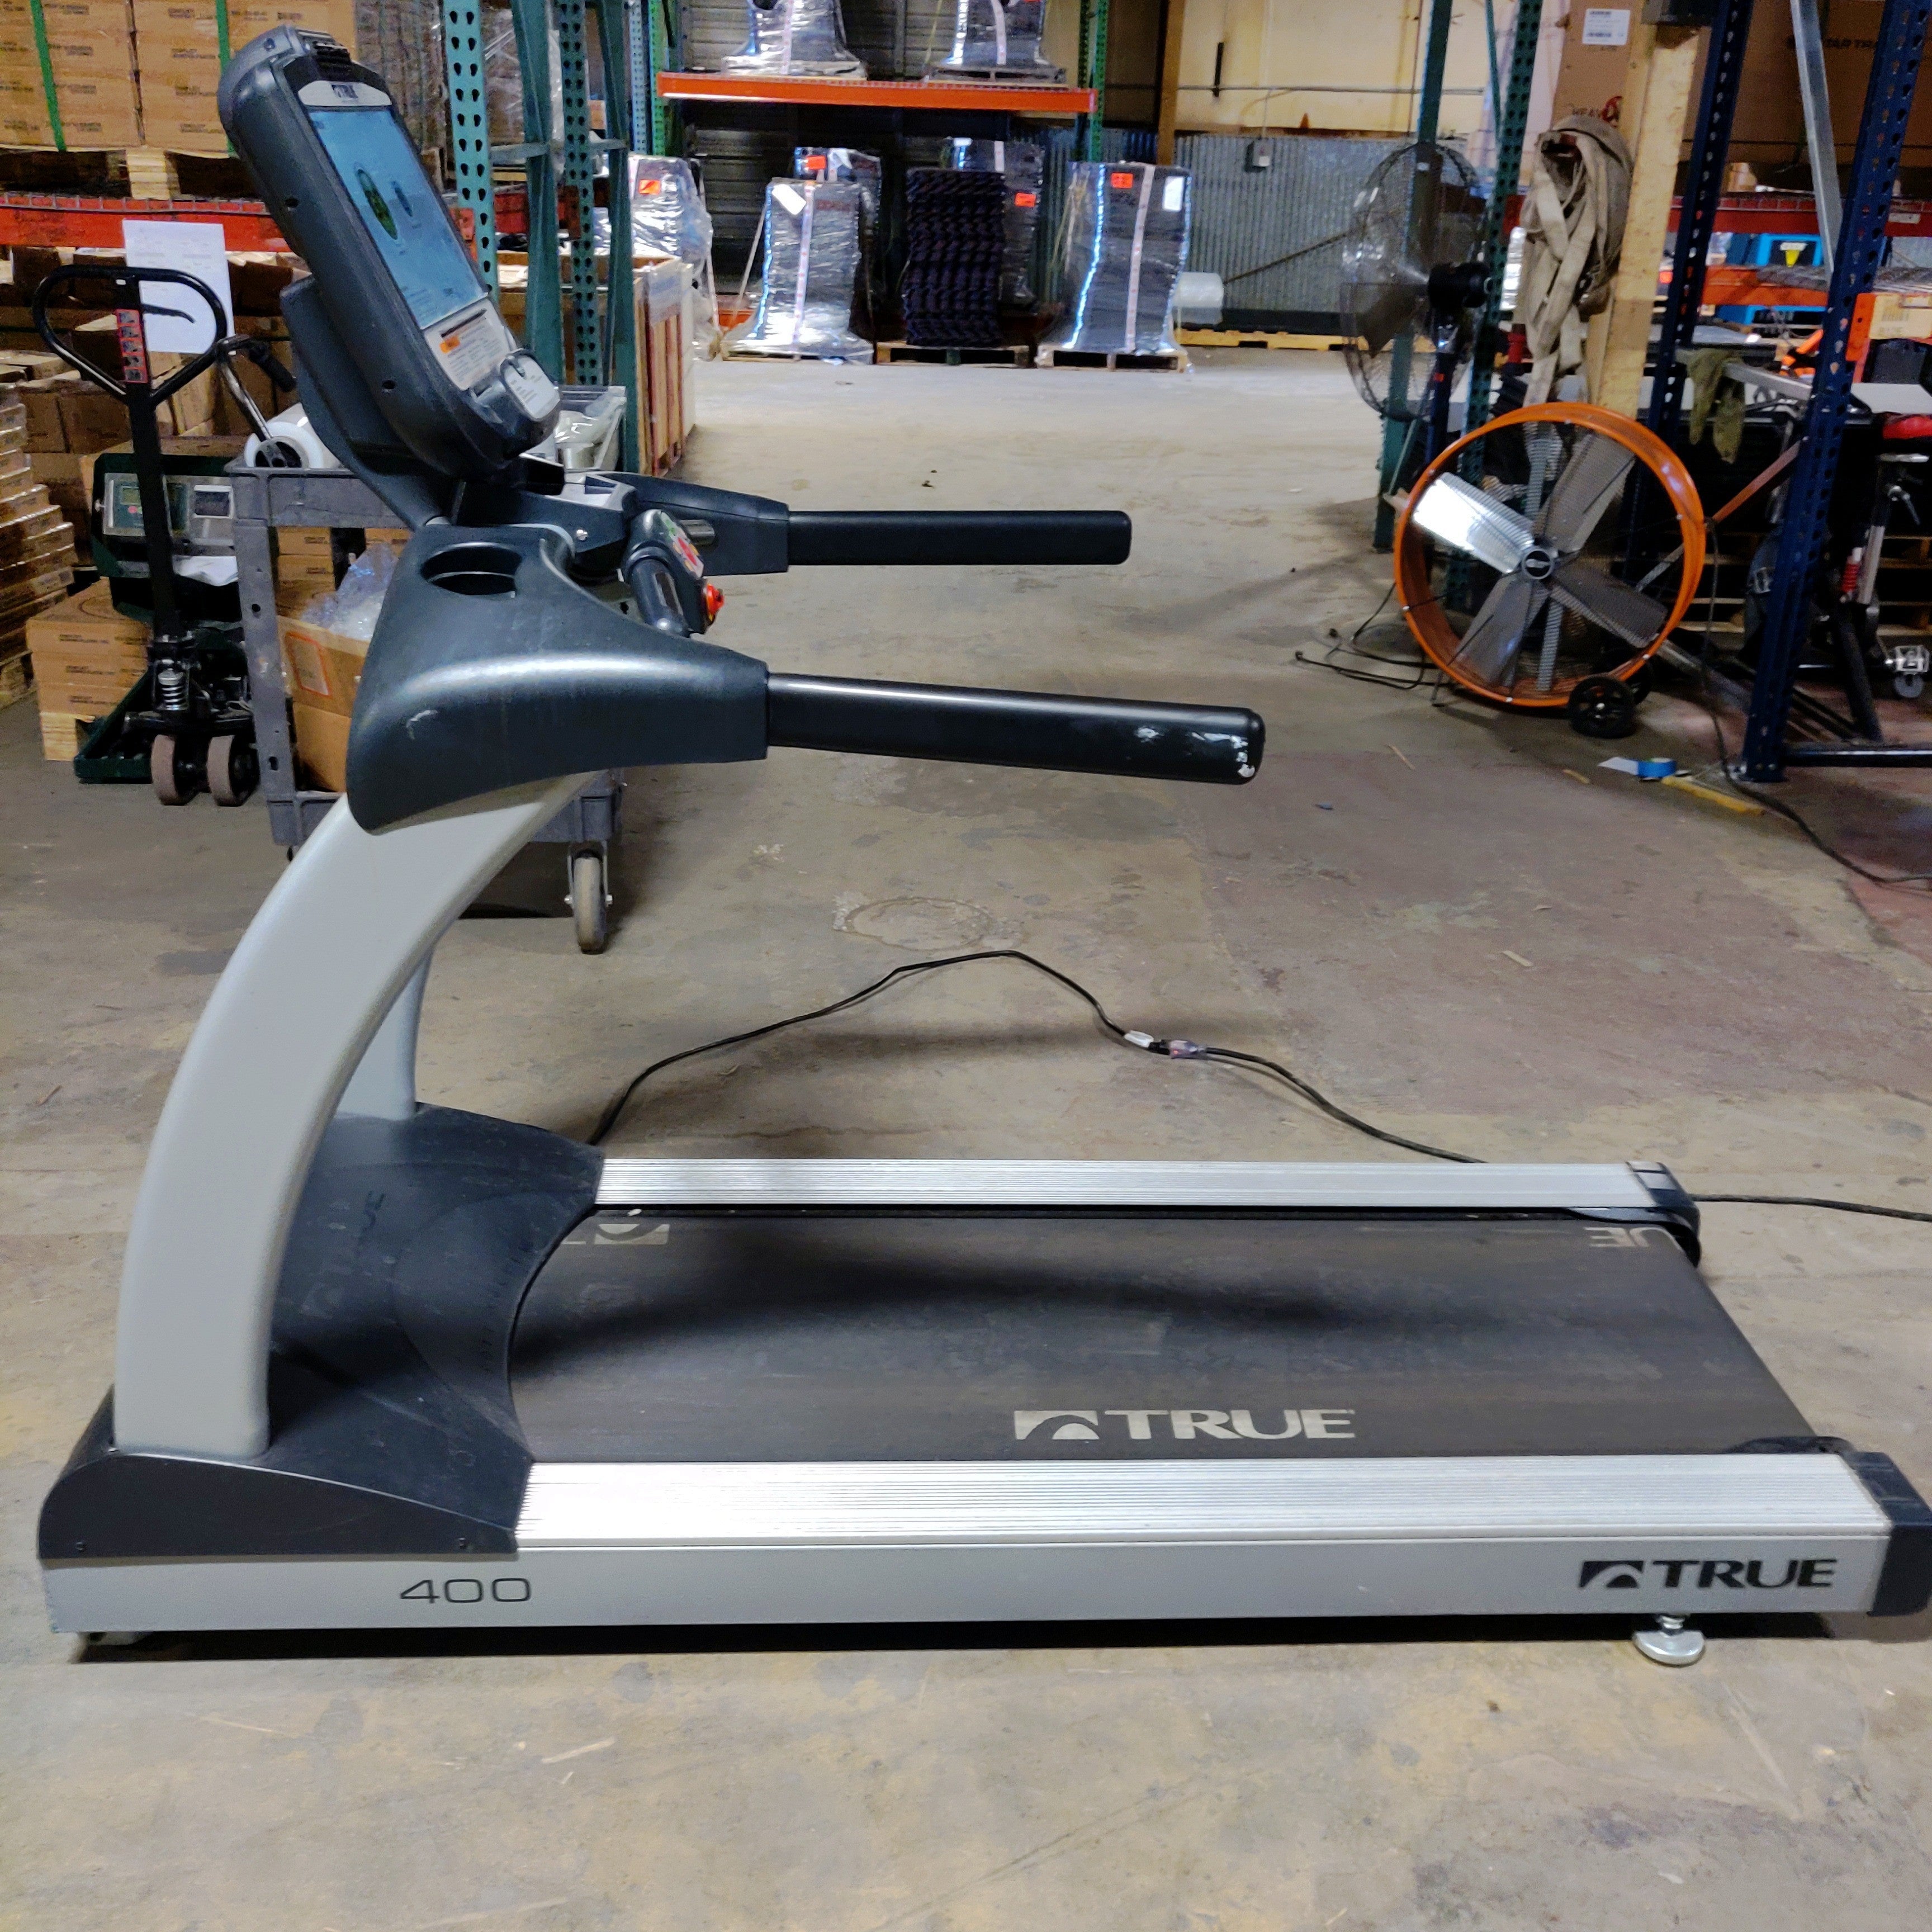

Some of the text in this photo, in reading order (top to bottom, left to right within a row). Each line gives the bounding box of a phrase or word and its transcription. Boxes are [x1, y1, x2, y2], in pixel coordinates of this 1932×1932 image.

[1105, 1409, 1355, 1439] TRUE
[1652, 1559, 1838, 1588] TRUE
[400, 1578, 531, 1603] 400
